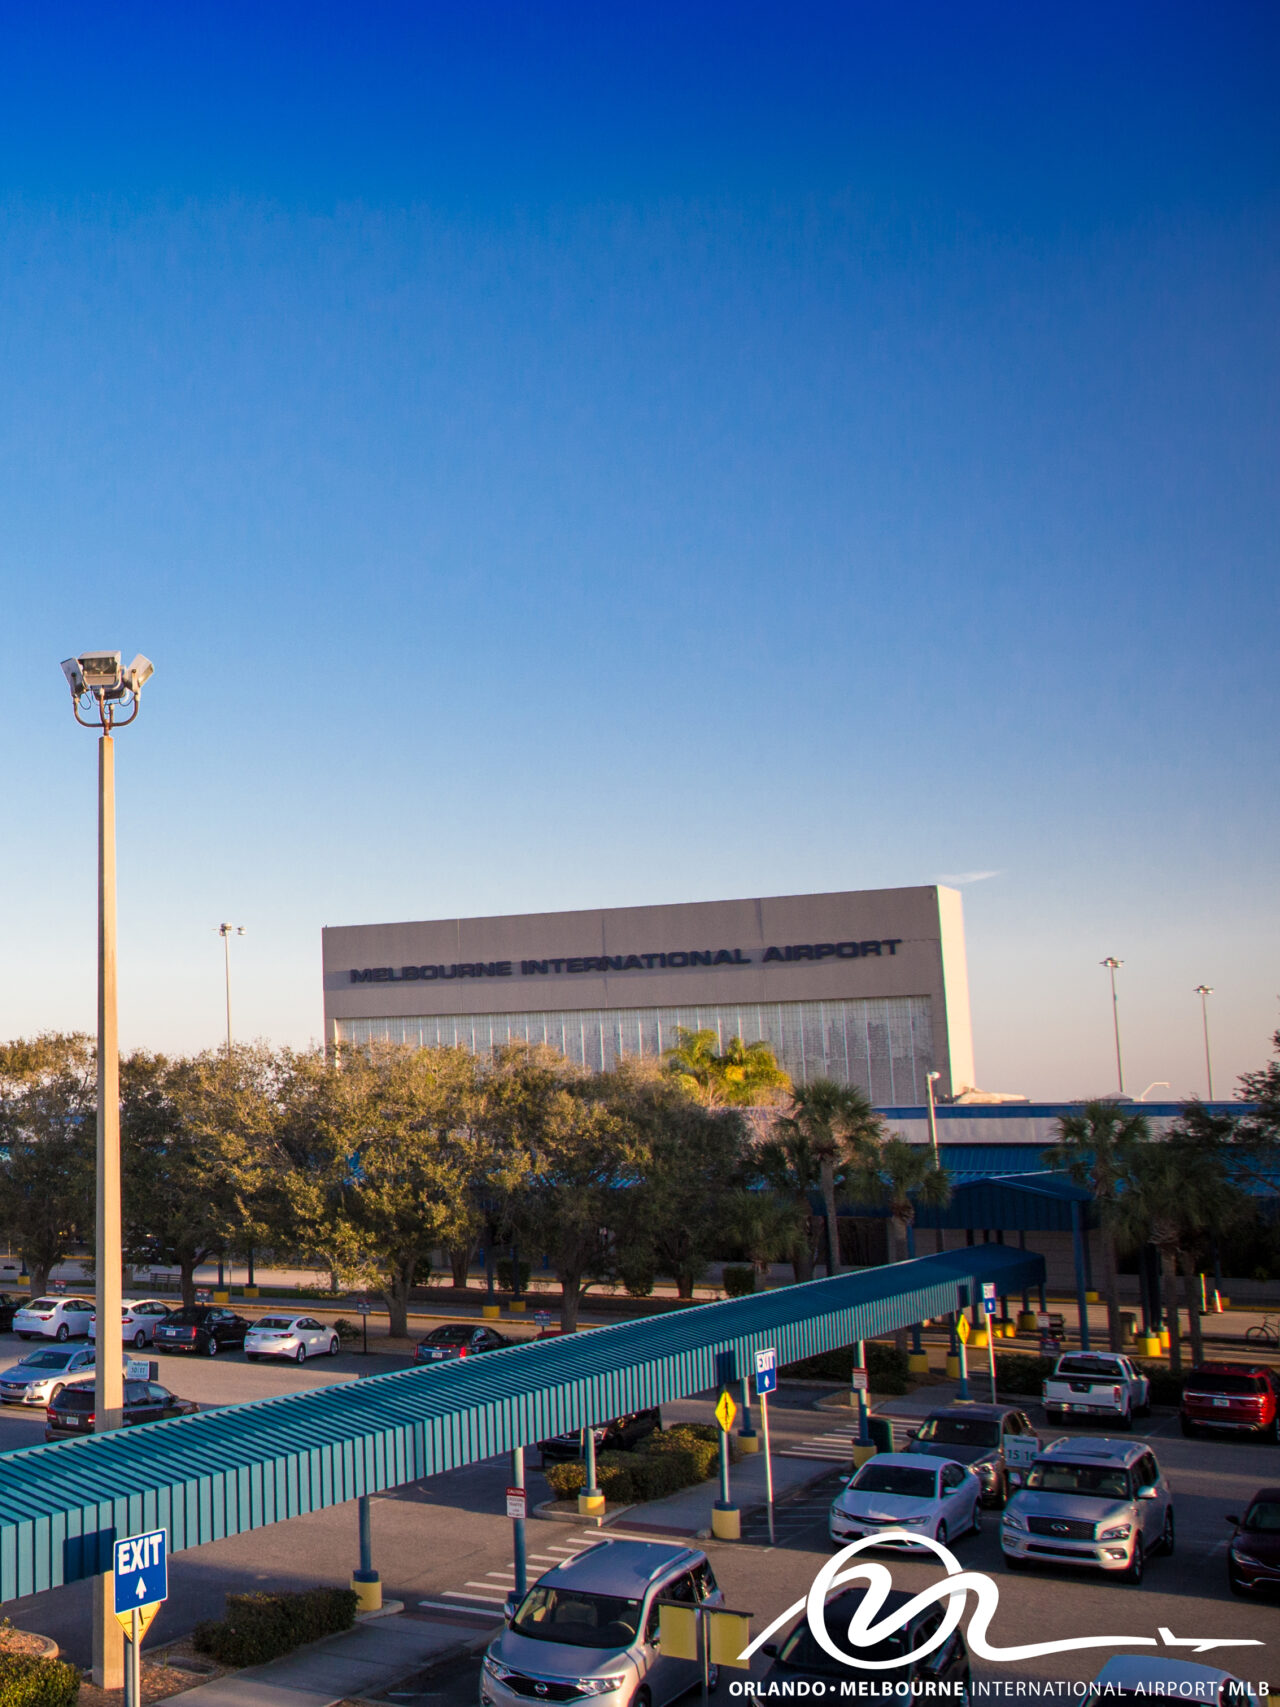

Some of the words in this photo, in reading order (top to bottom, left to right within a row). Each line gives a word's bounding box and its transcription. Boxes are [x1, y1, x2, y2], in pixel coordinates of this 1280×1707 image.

[350, 961, 512, 983] MELBOURNE
[521, 949, 751, 975] INTERNATIONAL
[762, 939, 902, 962] AIRPORT
[756, 1351, 775, 1374] EXIT
[1007, 1449, 1020, 1460] 15
[118, 1535, 162, 1575] EXIT
